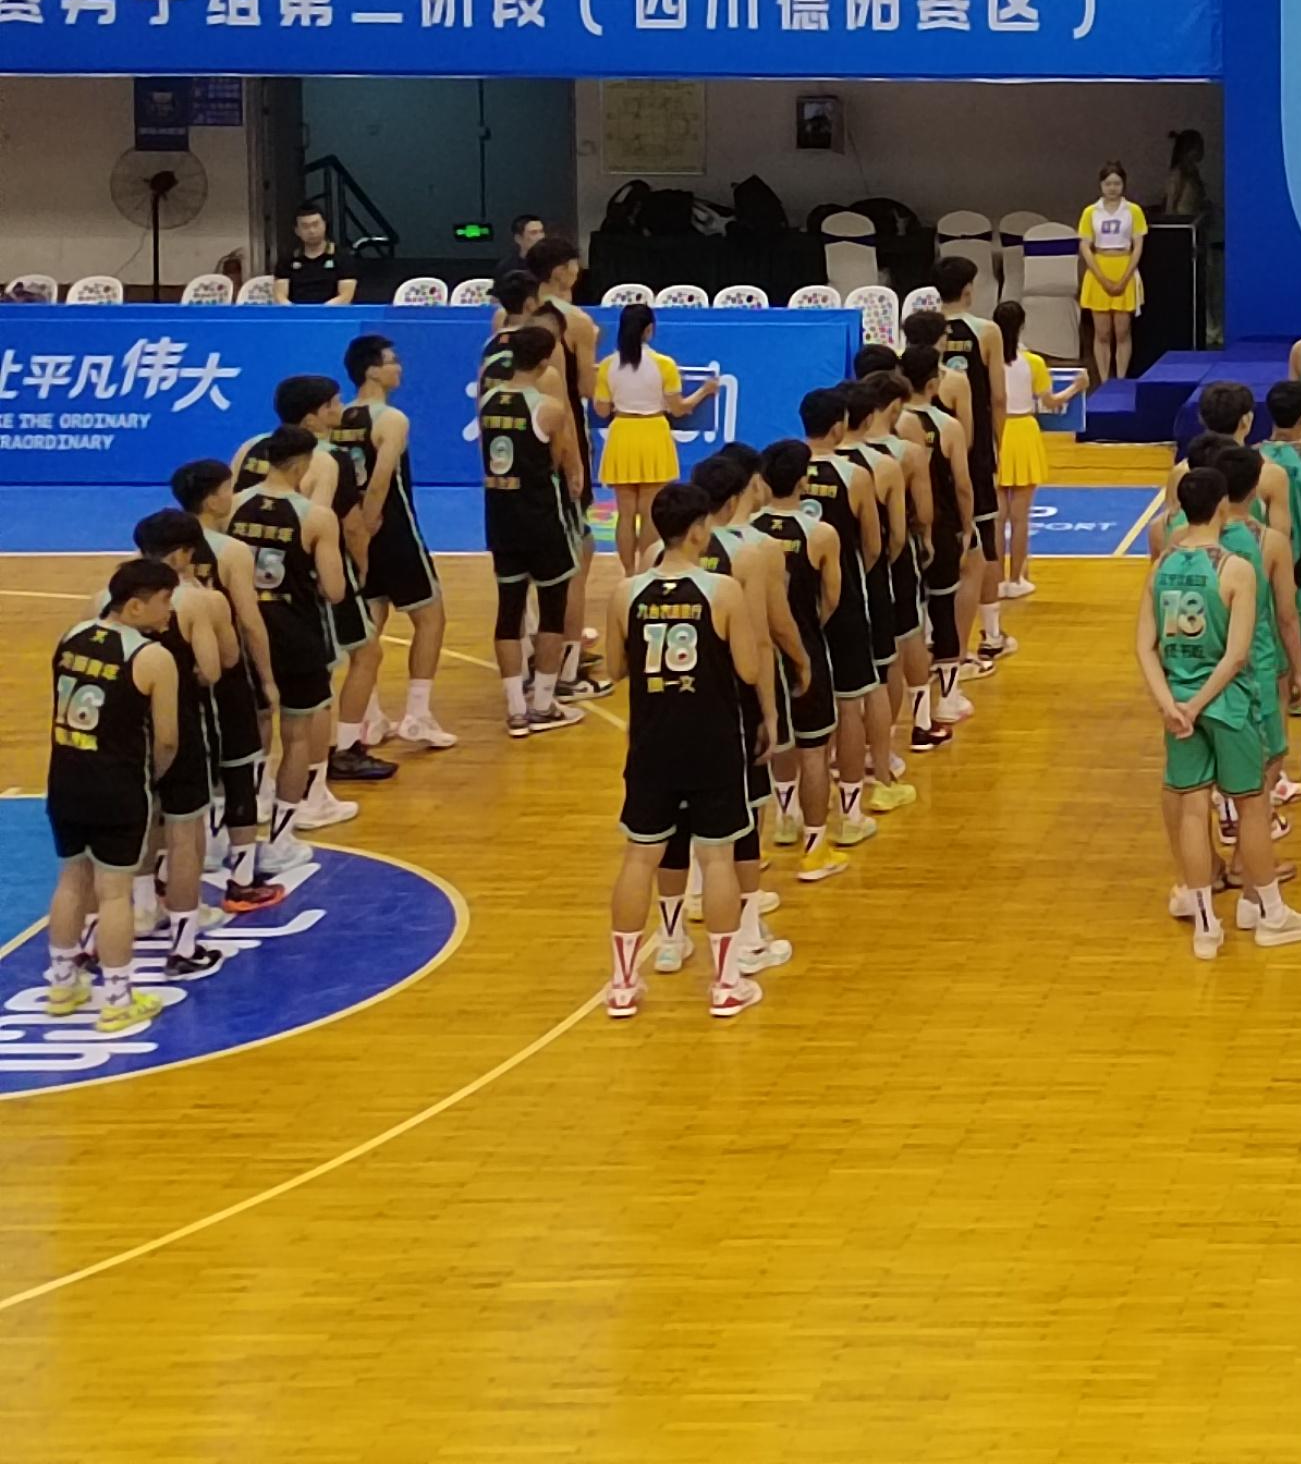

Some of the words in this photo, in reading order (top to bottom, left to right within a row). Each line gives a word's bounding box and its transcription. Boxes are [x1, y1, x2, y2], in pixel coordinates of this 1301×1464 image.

[59, 413, 152, 429] ORDINARY
[643, 622, 699, 674] 18
[55, 674, 107, 731] 16
